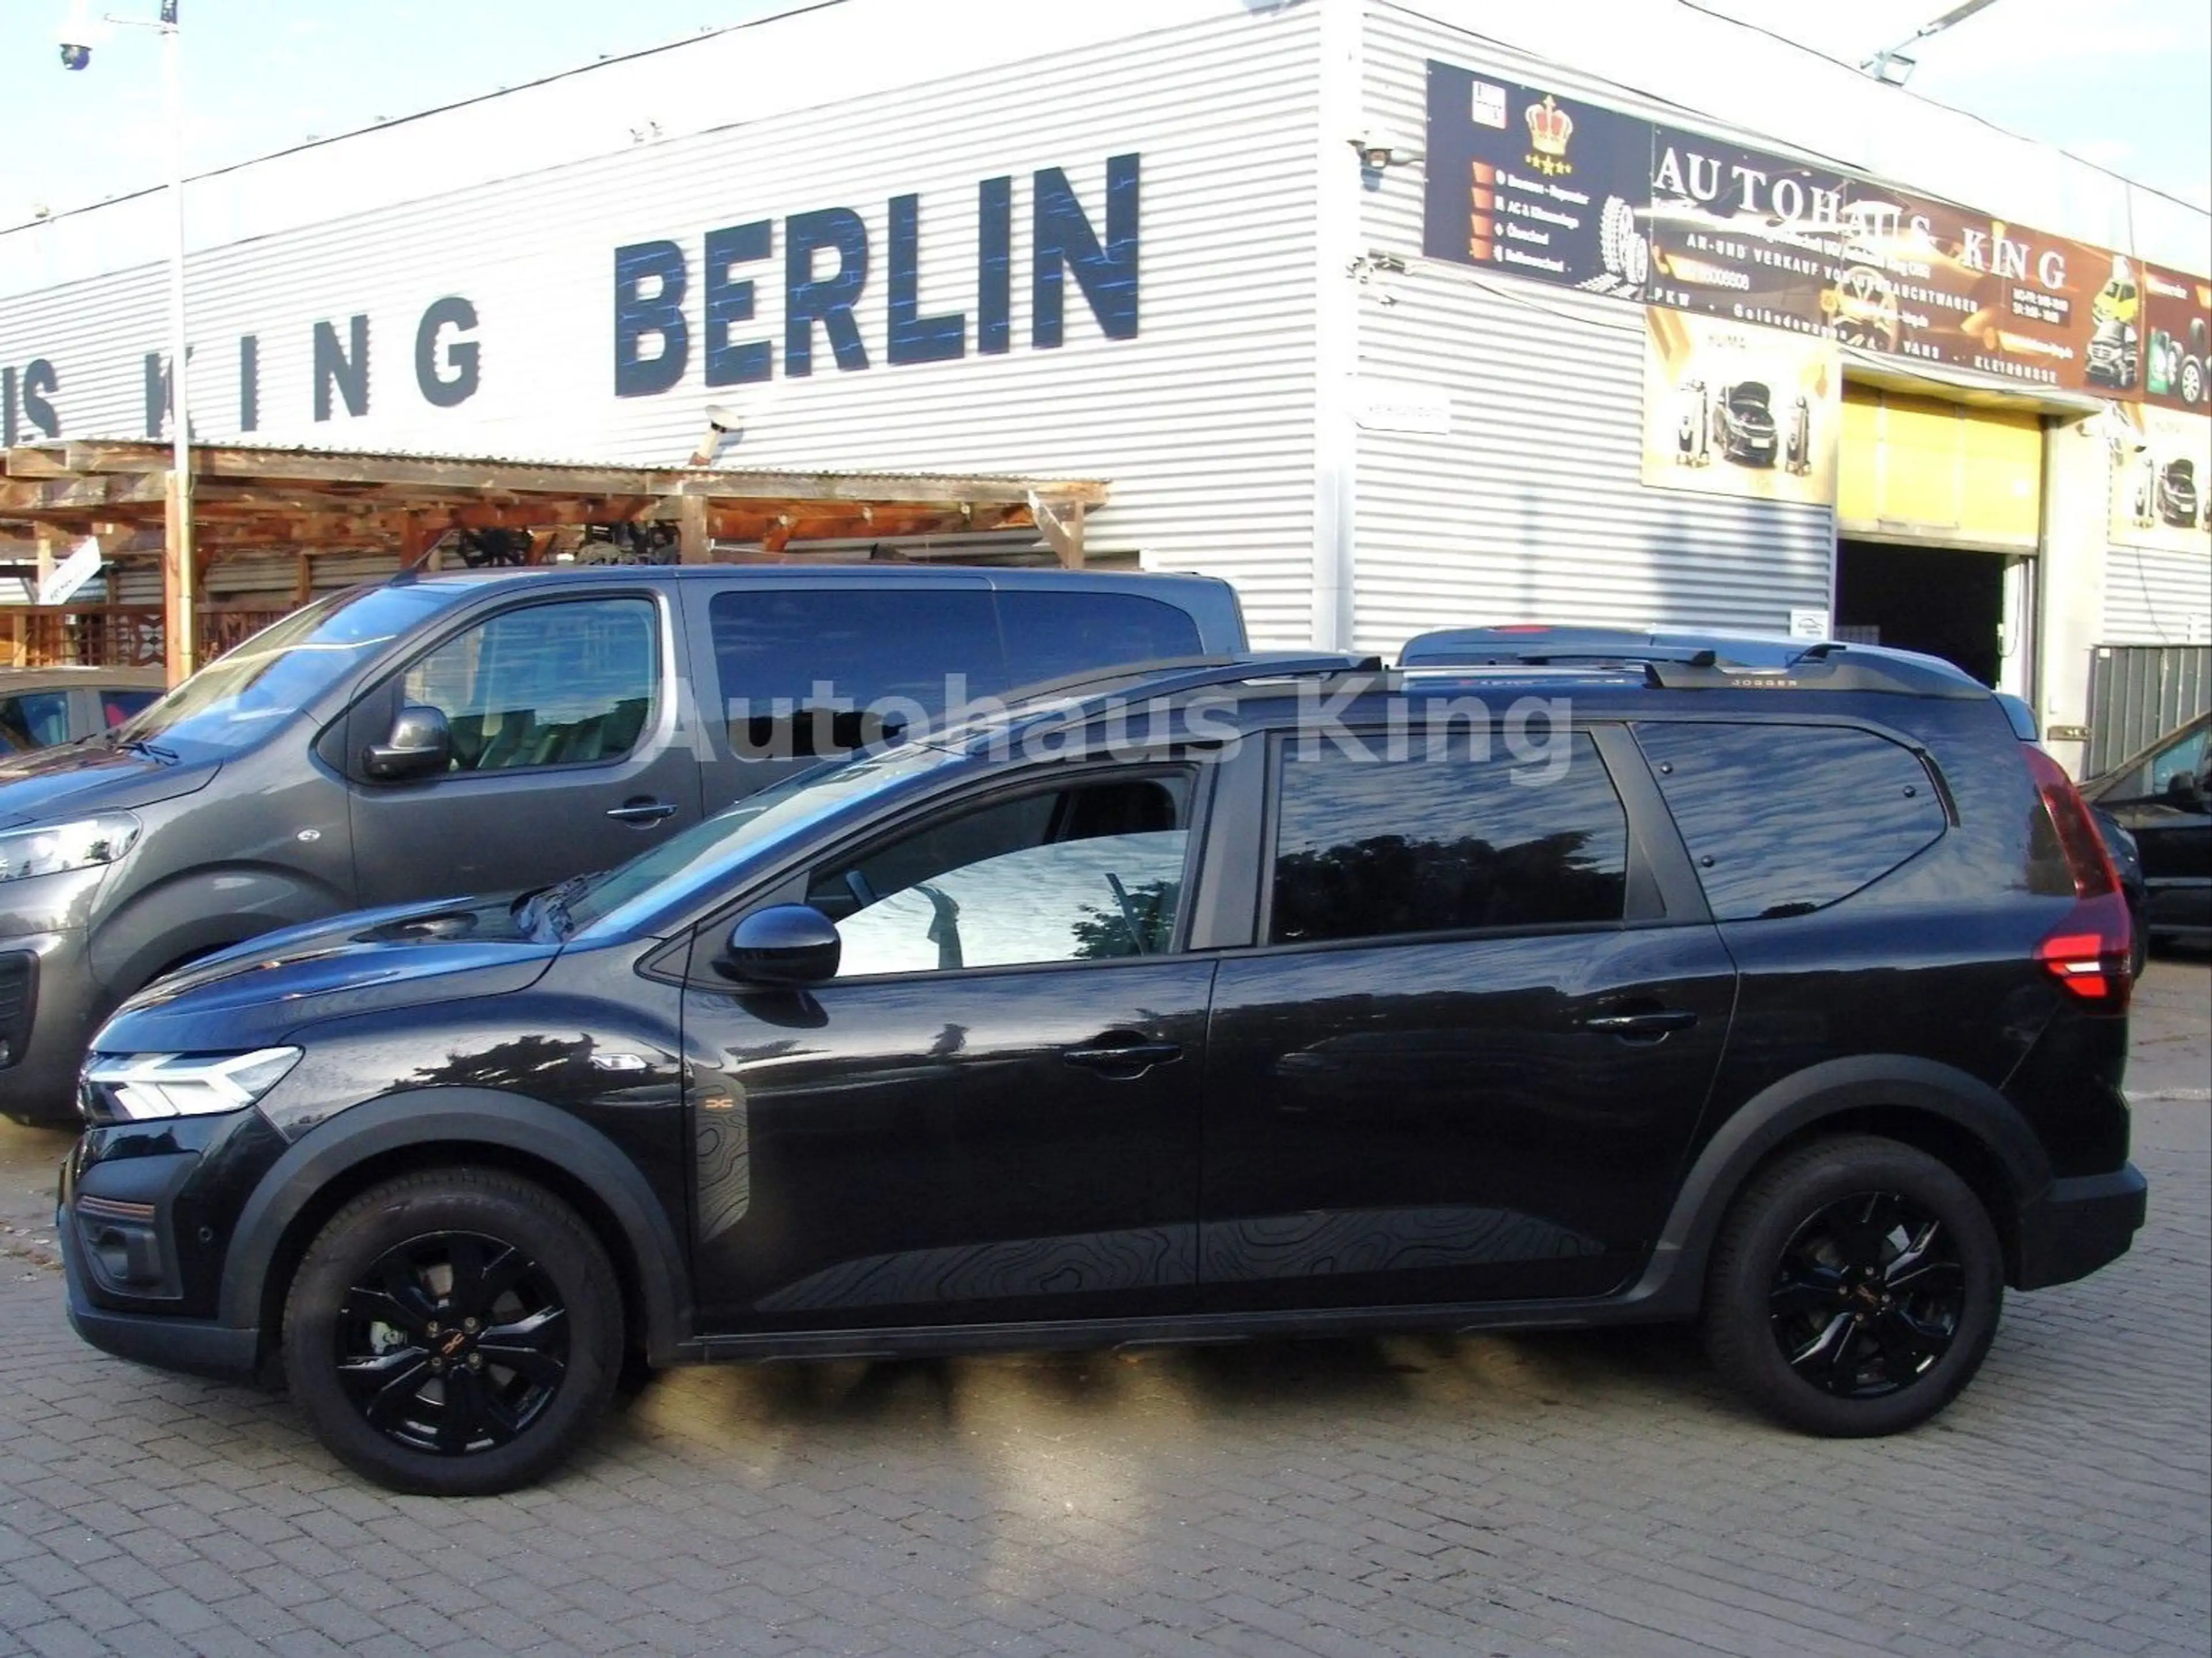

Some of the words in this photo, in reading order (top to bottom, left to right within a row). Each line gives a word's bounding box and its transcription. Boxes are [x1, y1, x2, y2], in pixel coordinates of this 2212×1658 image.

[1753, 248, 1819, 275] VERKAUF
[1961, 227, 2066, 290] KING
[145, 297, 480, 438] KING
[614, 151, 1141, 398] BERLIN
[1654, 287, 1691, 307] PKW
